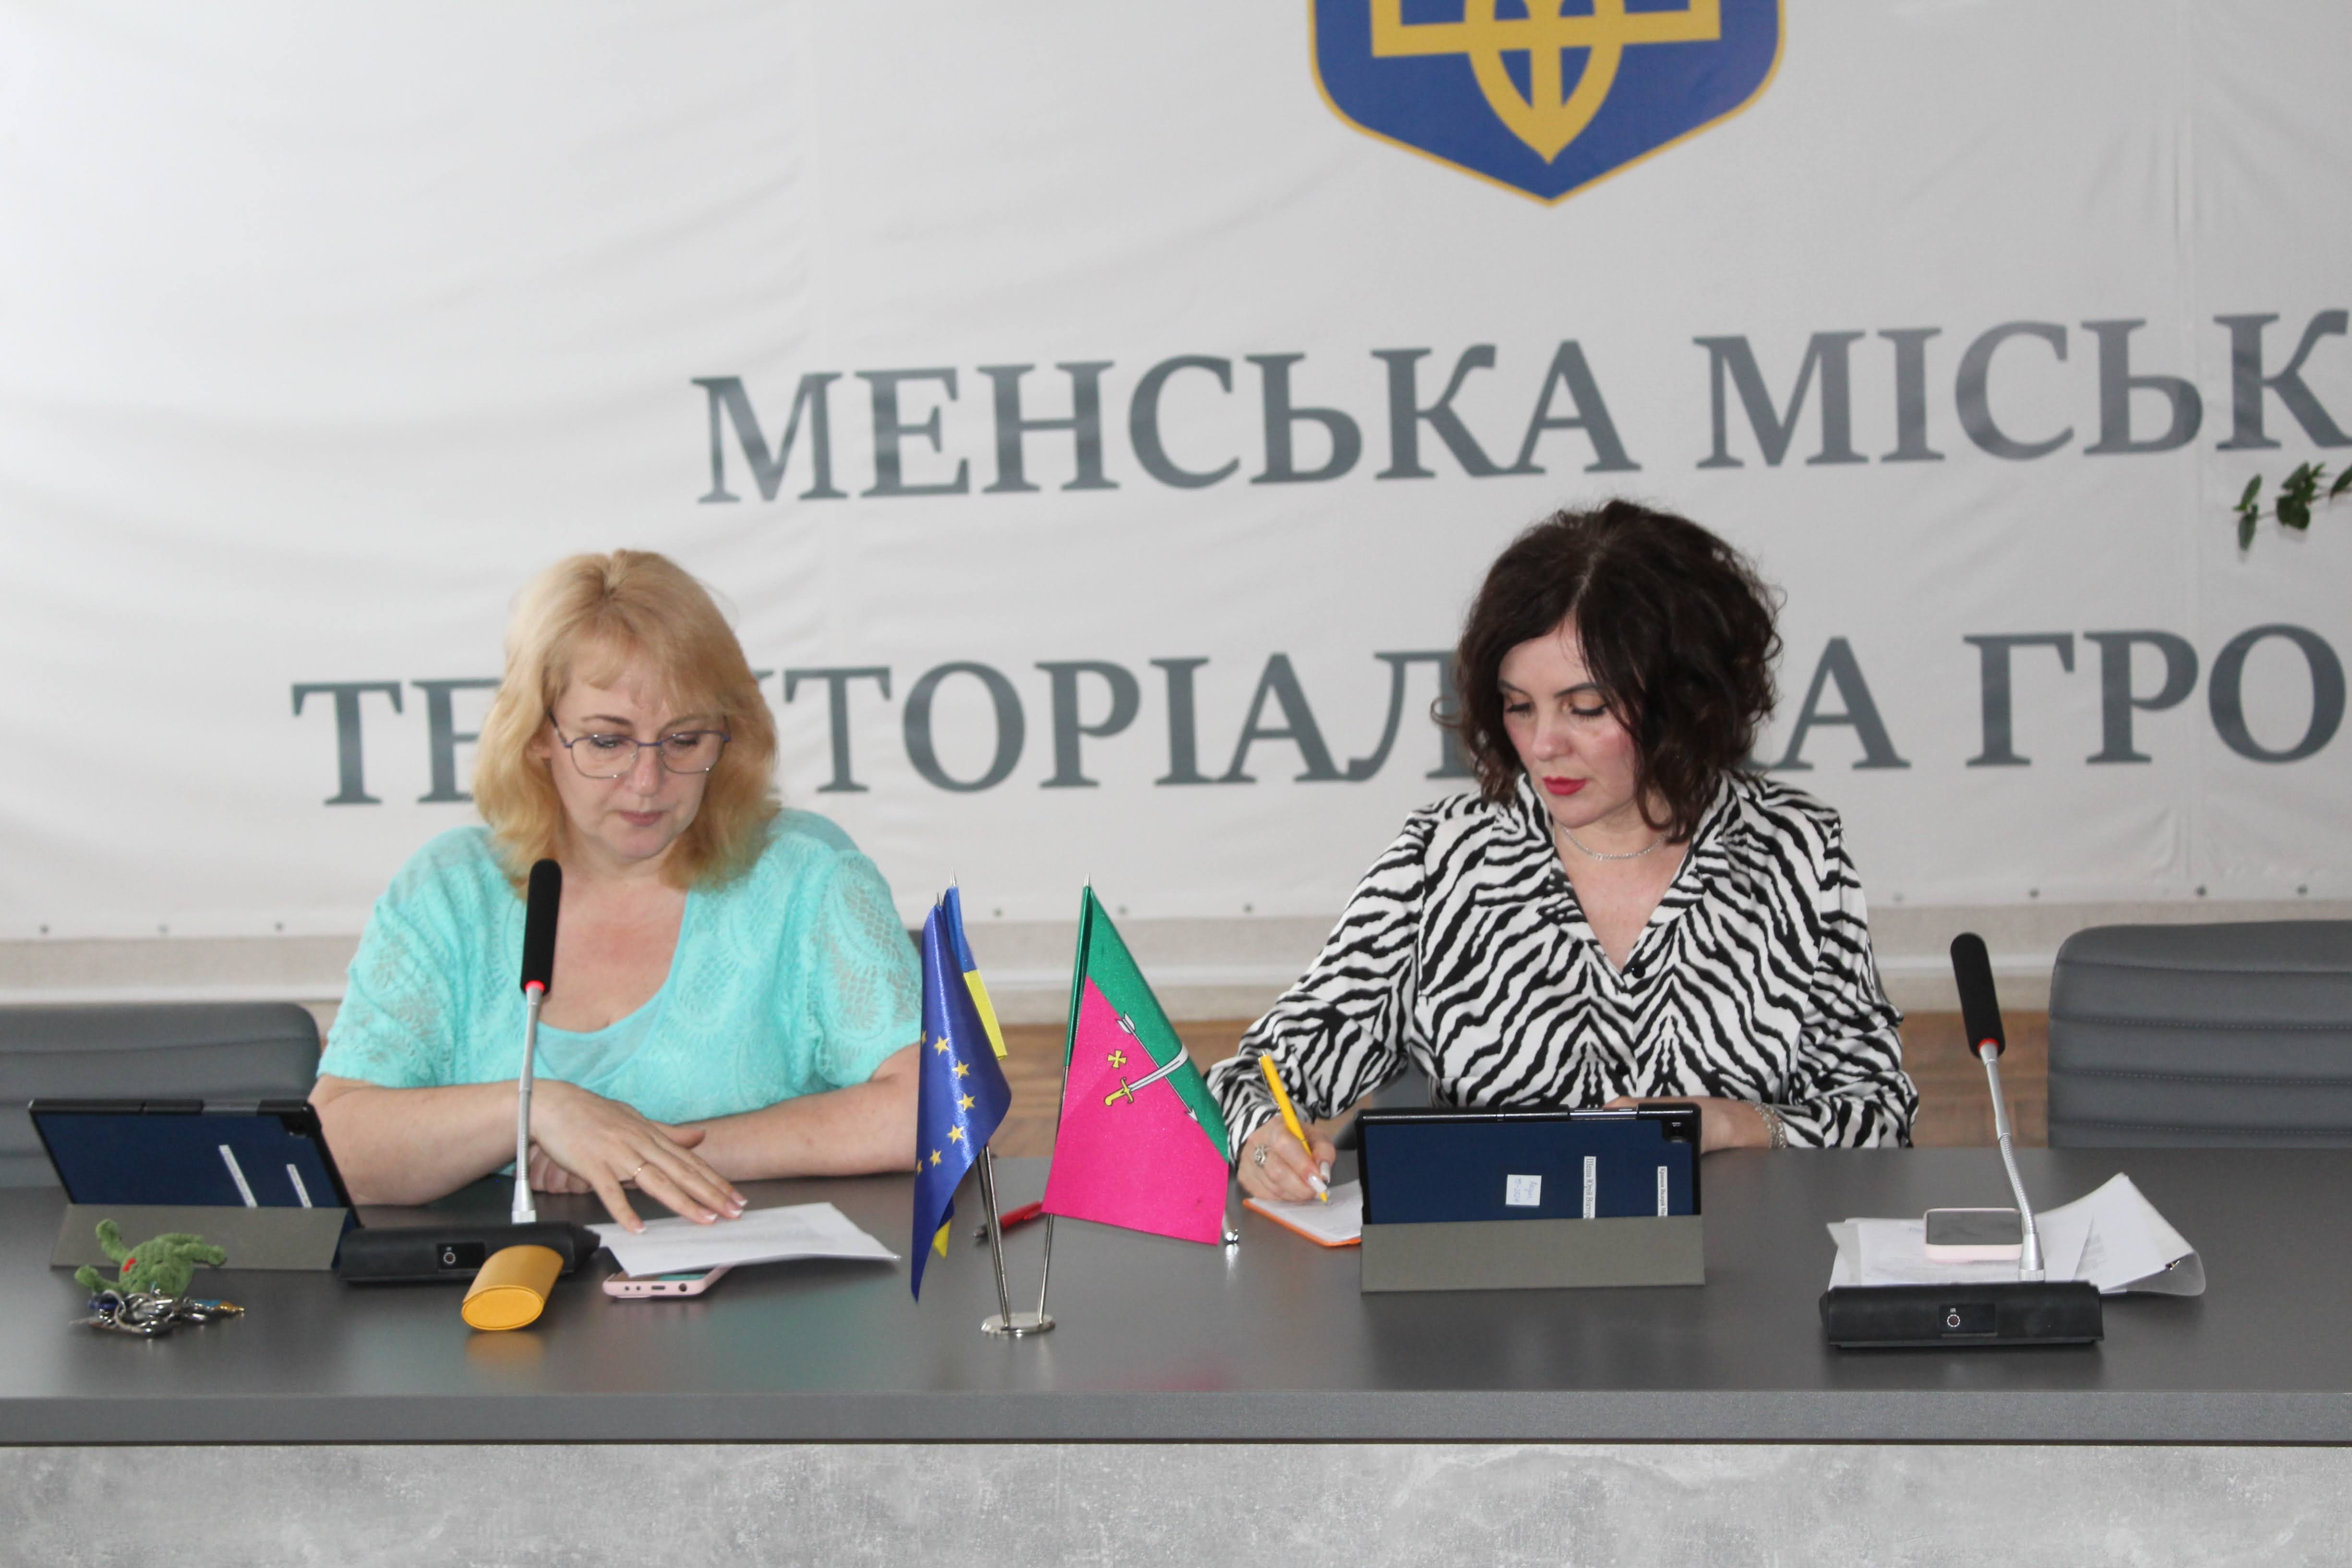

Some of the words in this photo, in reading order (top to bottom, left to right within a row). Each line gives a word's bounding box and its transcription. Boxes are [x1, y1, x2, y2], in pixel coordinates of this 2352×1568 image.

[690, 339, 1642, 503] МЕНСЬКА
[290, 636, 1912, 807] ТЕТОРІАЛА
[1963, 623, 2347, 767] ГРО
